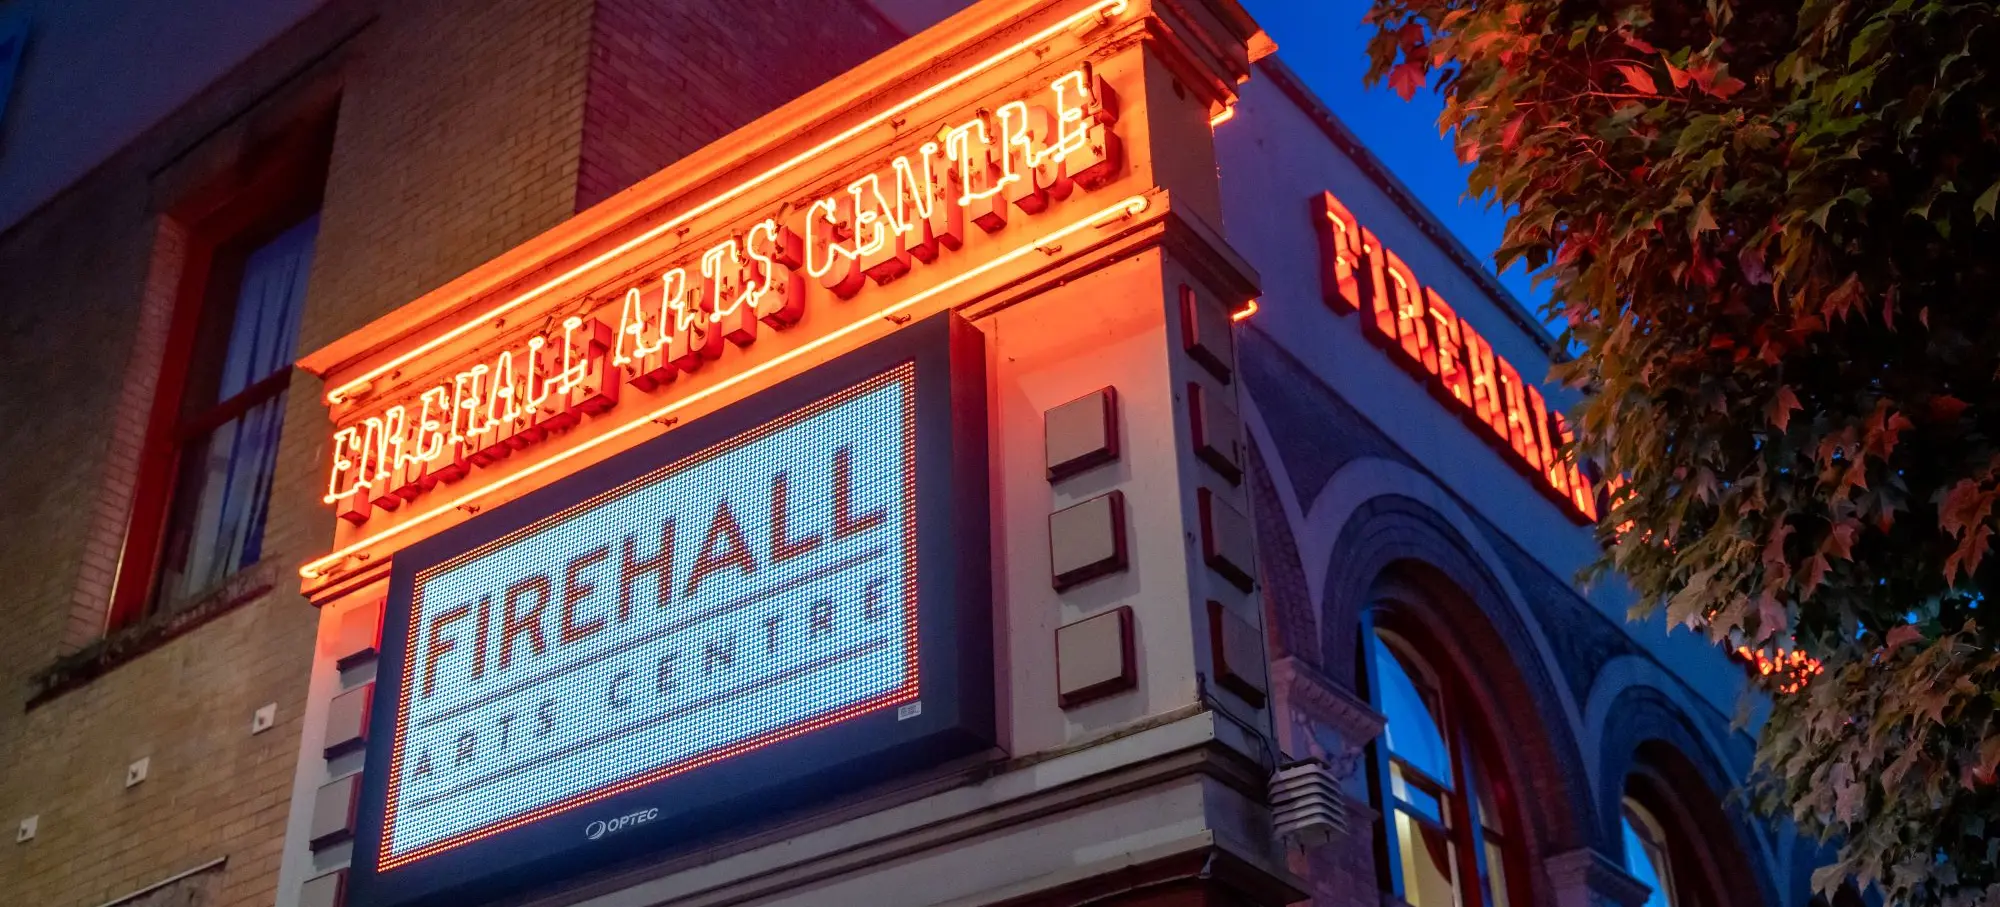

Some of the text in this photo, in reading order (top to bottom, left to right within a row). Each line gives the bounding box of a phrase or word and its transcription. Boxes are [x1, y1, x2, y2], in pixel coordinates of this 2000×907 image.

[324, 66, 1121, 523] FIREHALL ARTS CENTRE
[415, 577, 886, 780] ARTS CENTRE
[422, 446, 888, 697] FIREHALL
[607, 807, 659, 832] OPTEC
